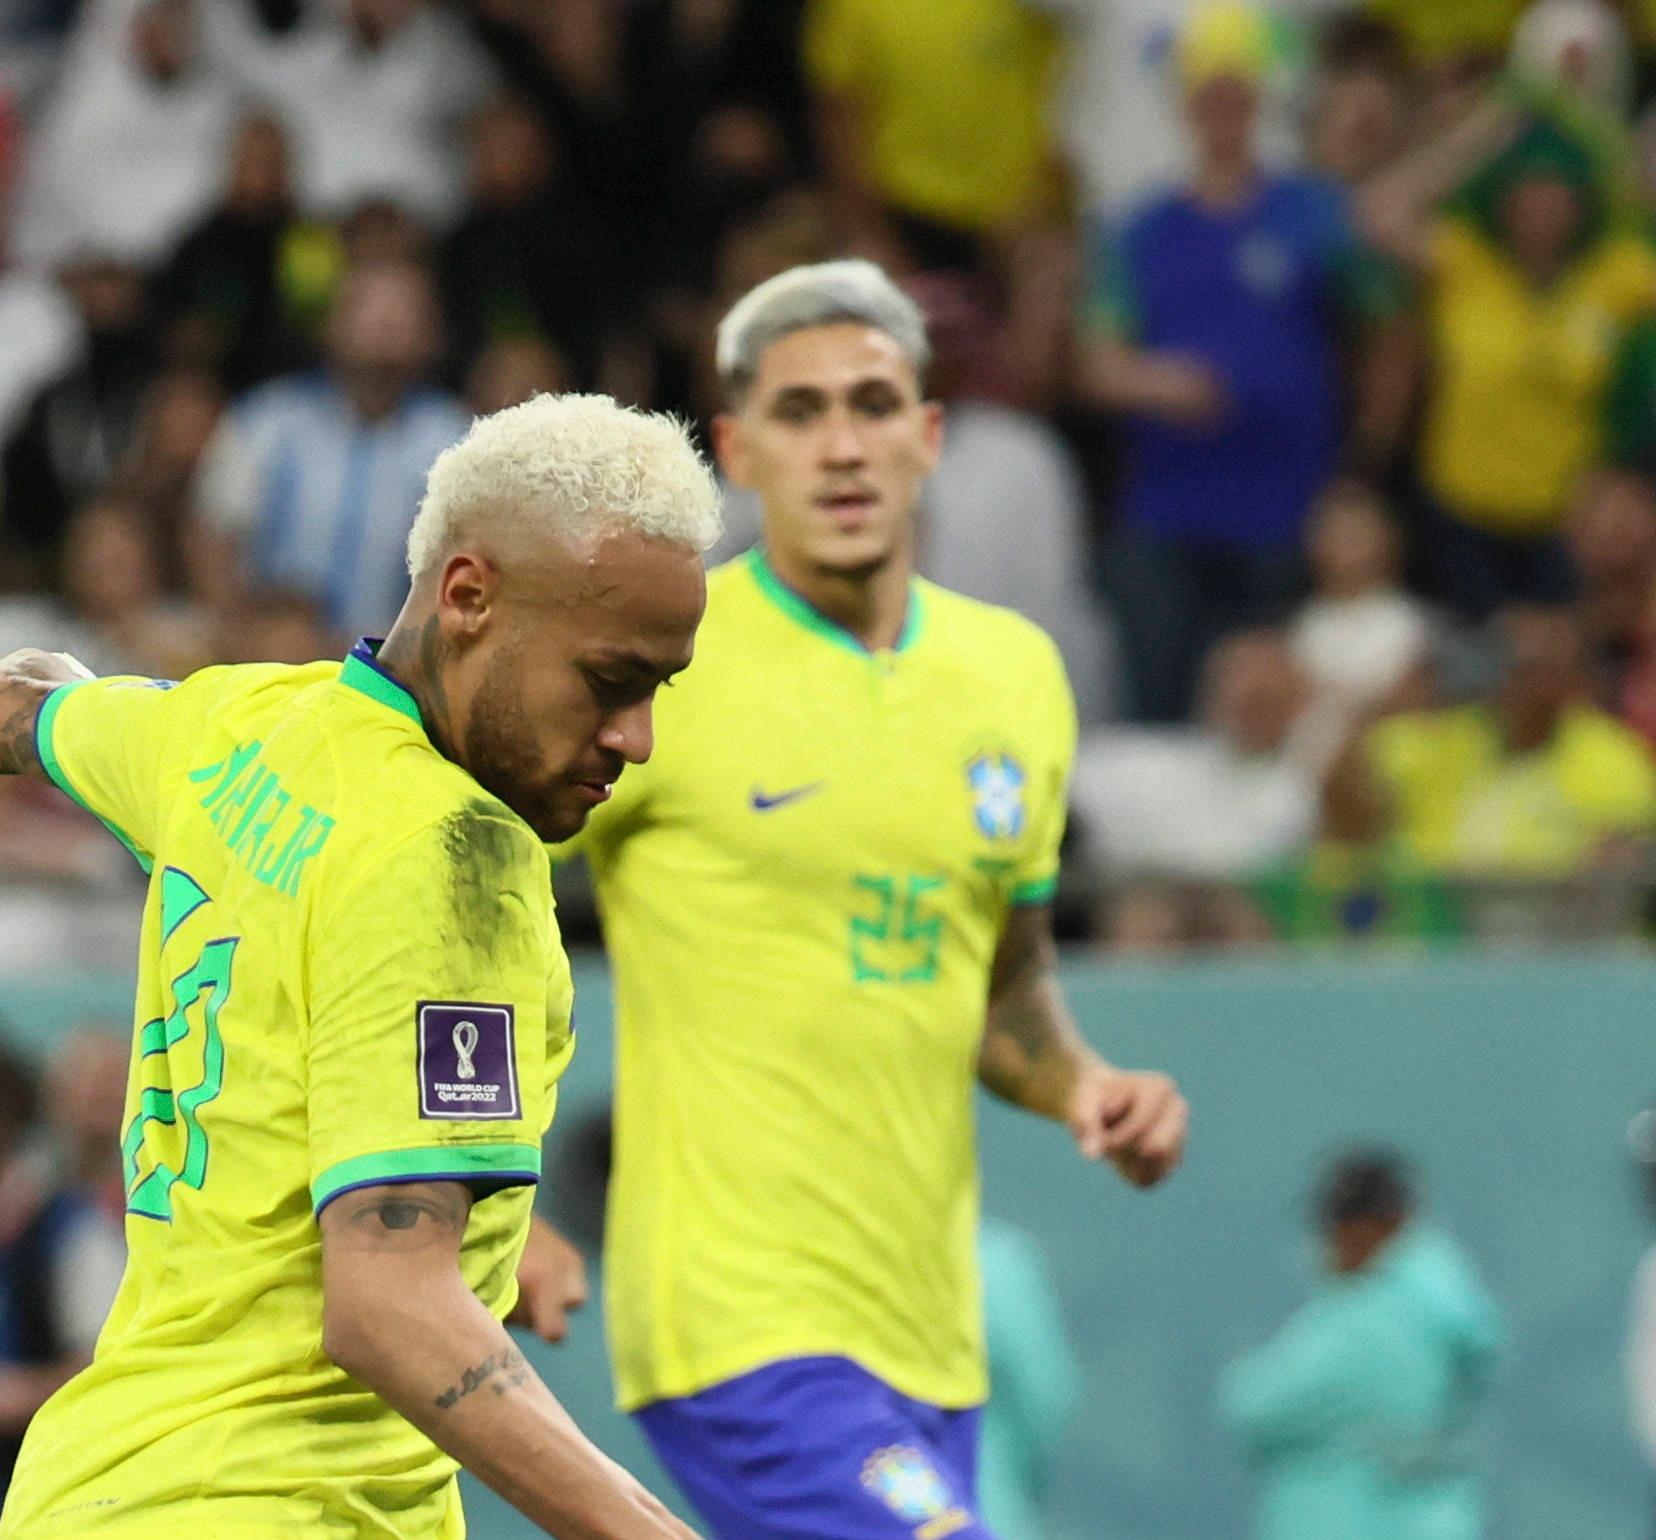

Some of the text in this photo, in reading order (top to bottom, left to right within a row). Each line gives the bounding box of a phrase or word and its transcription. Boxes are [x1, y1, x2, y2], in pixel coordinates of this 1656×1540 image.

[849, 874, 946, 982] 25
[434, 1083, 452, 1091] FIFA
[453, 1084, 481, 1092] WORLD
